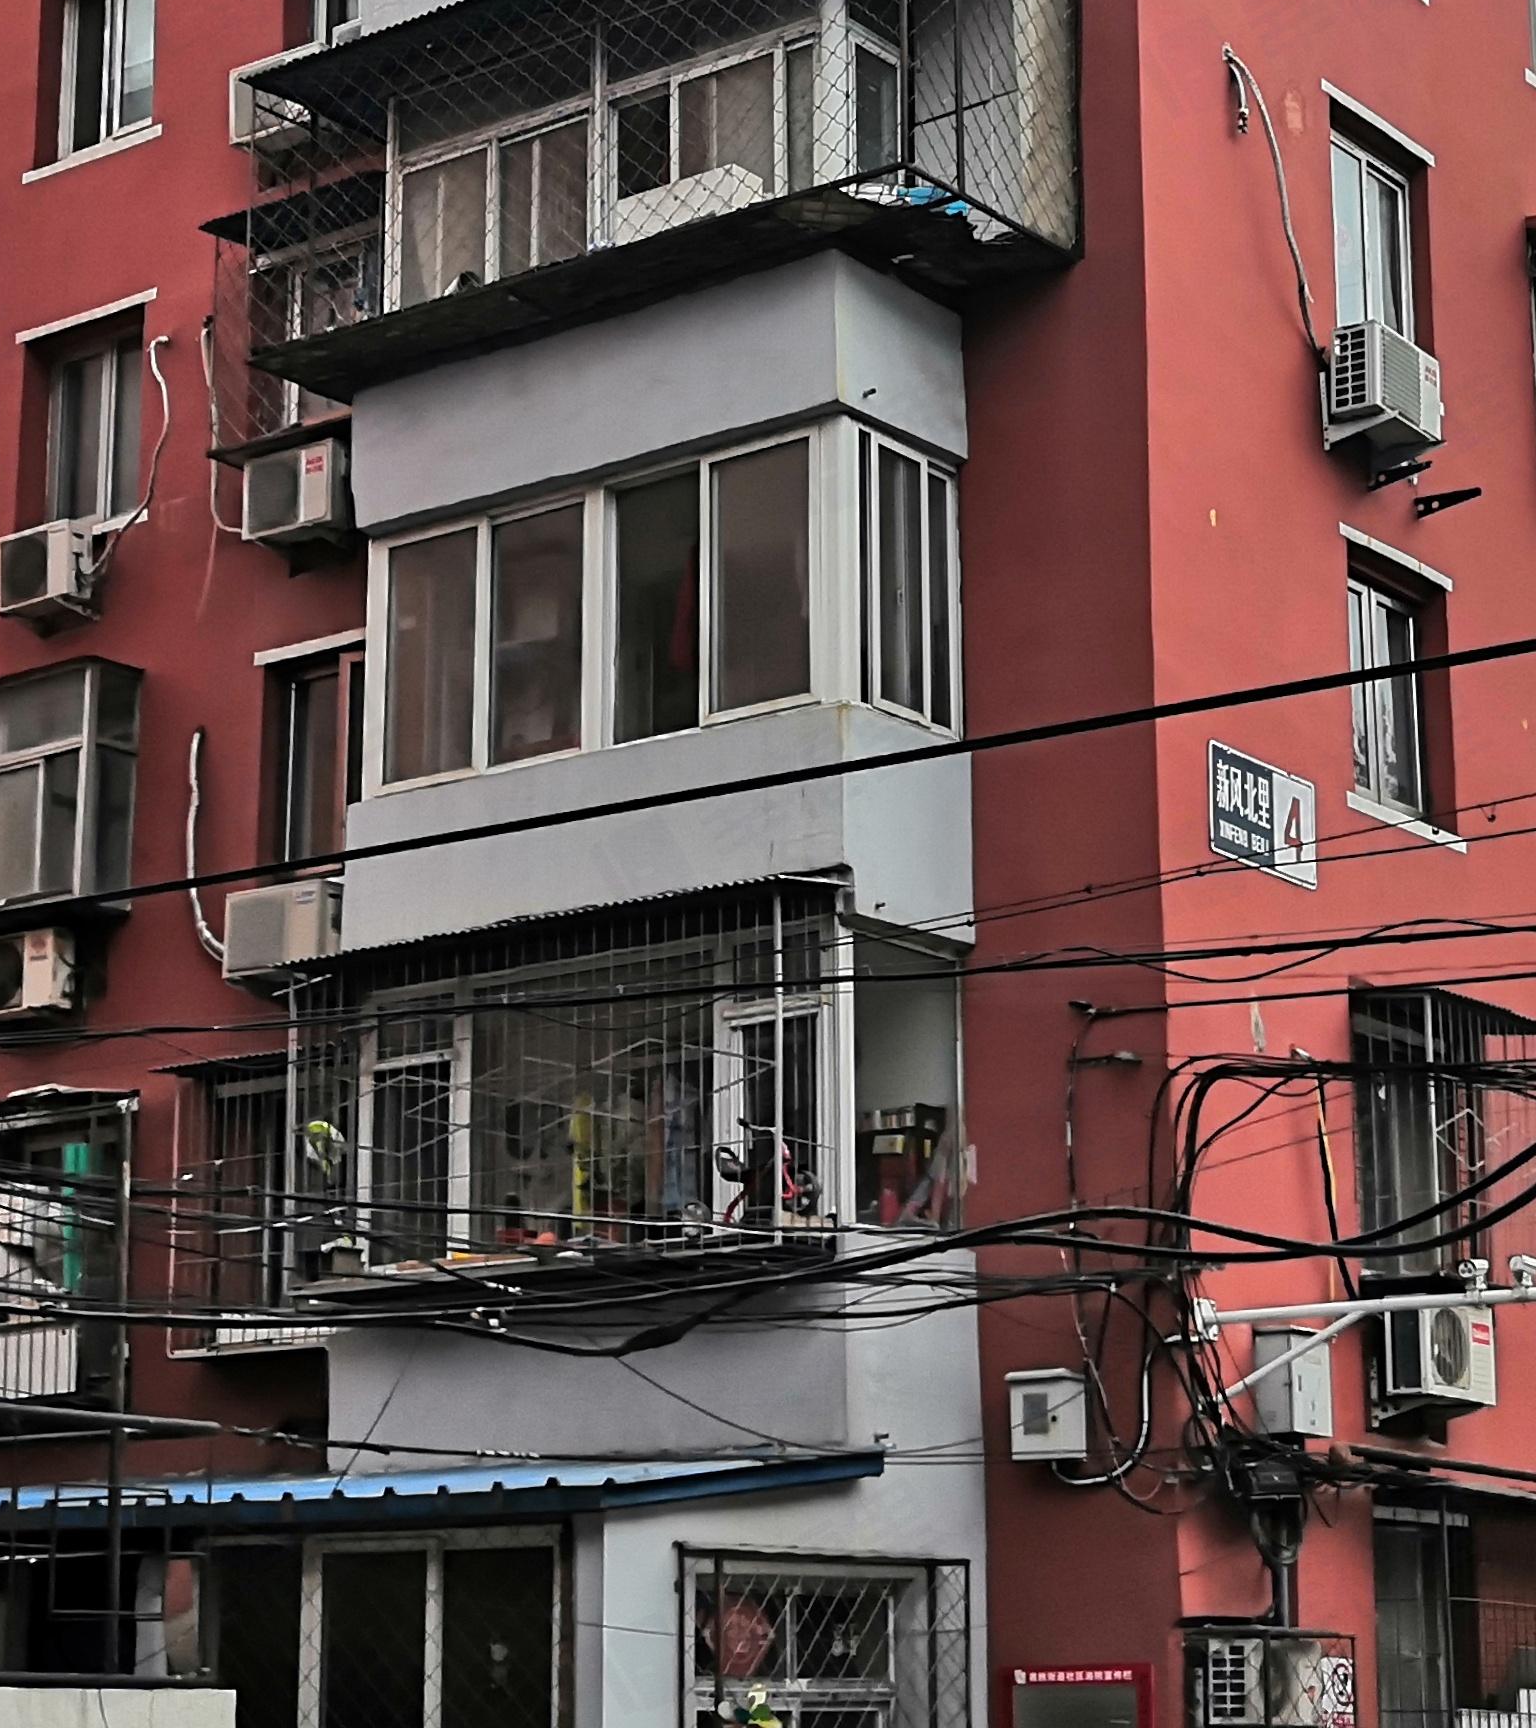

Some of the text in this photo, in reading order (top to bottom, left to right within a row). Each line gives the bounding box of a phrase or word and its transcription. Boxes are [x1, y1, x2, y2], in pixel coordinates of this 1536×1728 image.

[1216, 759, 1302, 862] 新风北里 4
[1219, 819, 1248, 847] XINFENG
